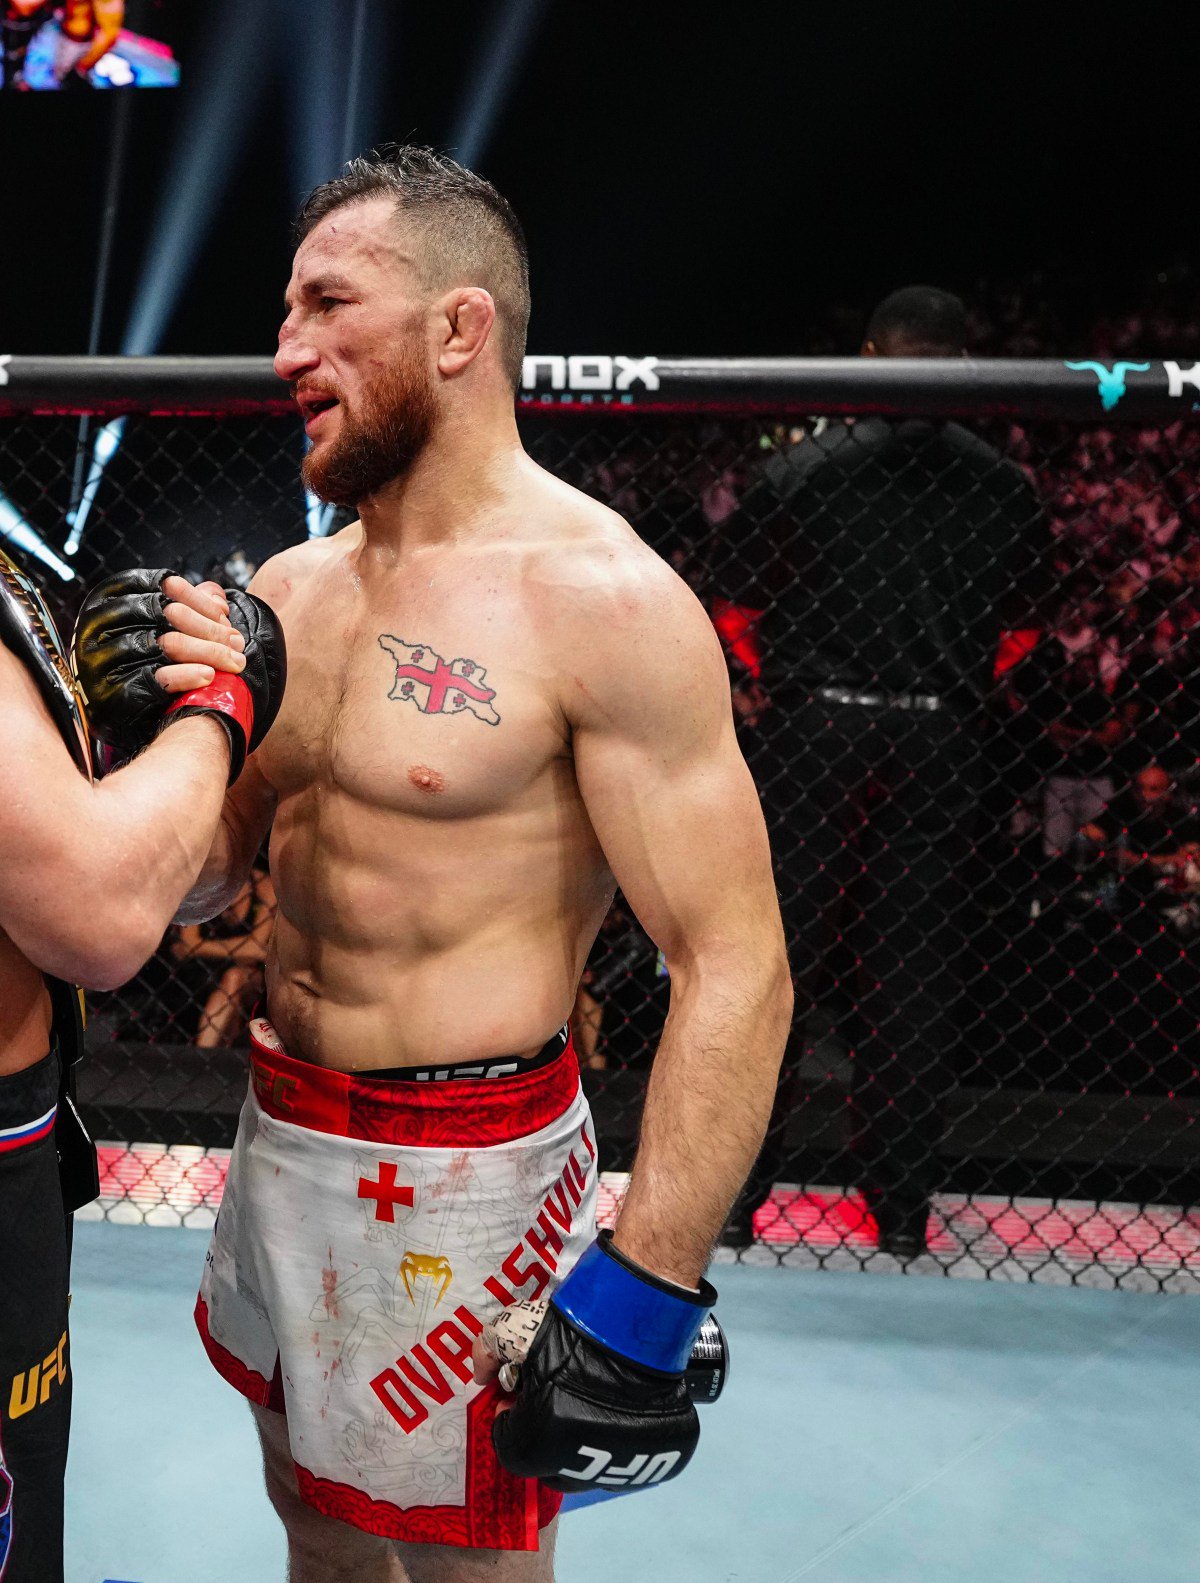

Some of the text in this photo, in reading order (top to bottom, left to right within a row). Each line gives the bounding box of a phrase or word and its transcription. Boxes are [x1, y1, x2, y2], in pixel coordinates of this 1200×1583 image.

[252, 1063, 297, 1112] FC
[8, 1330, 67, 1420] UFC
[558, 1445, 682, 1486] UFC
